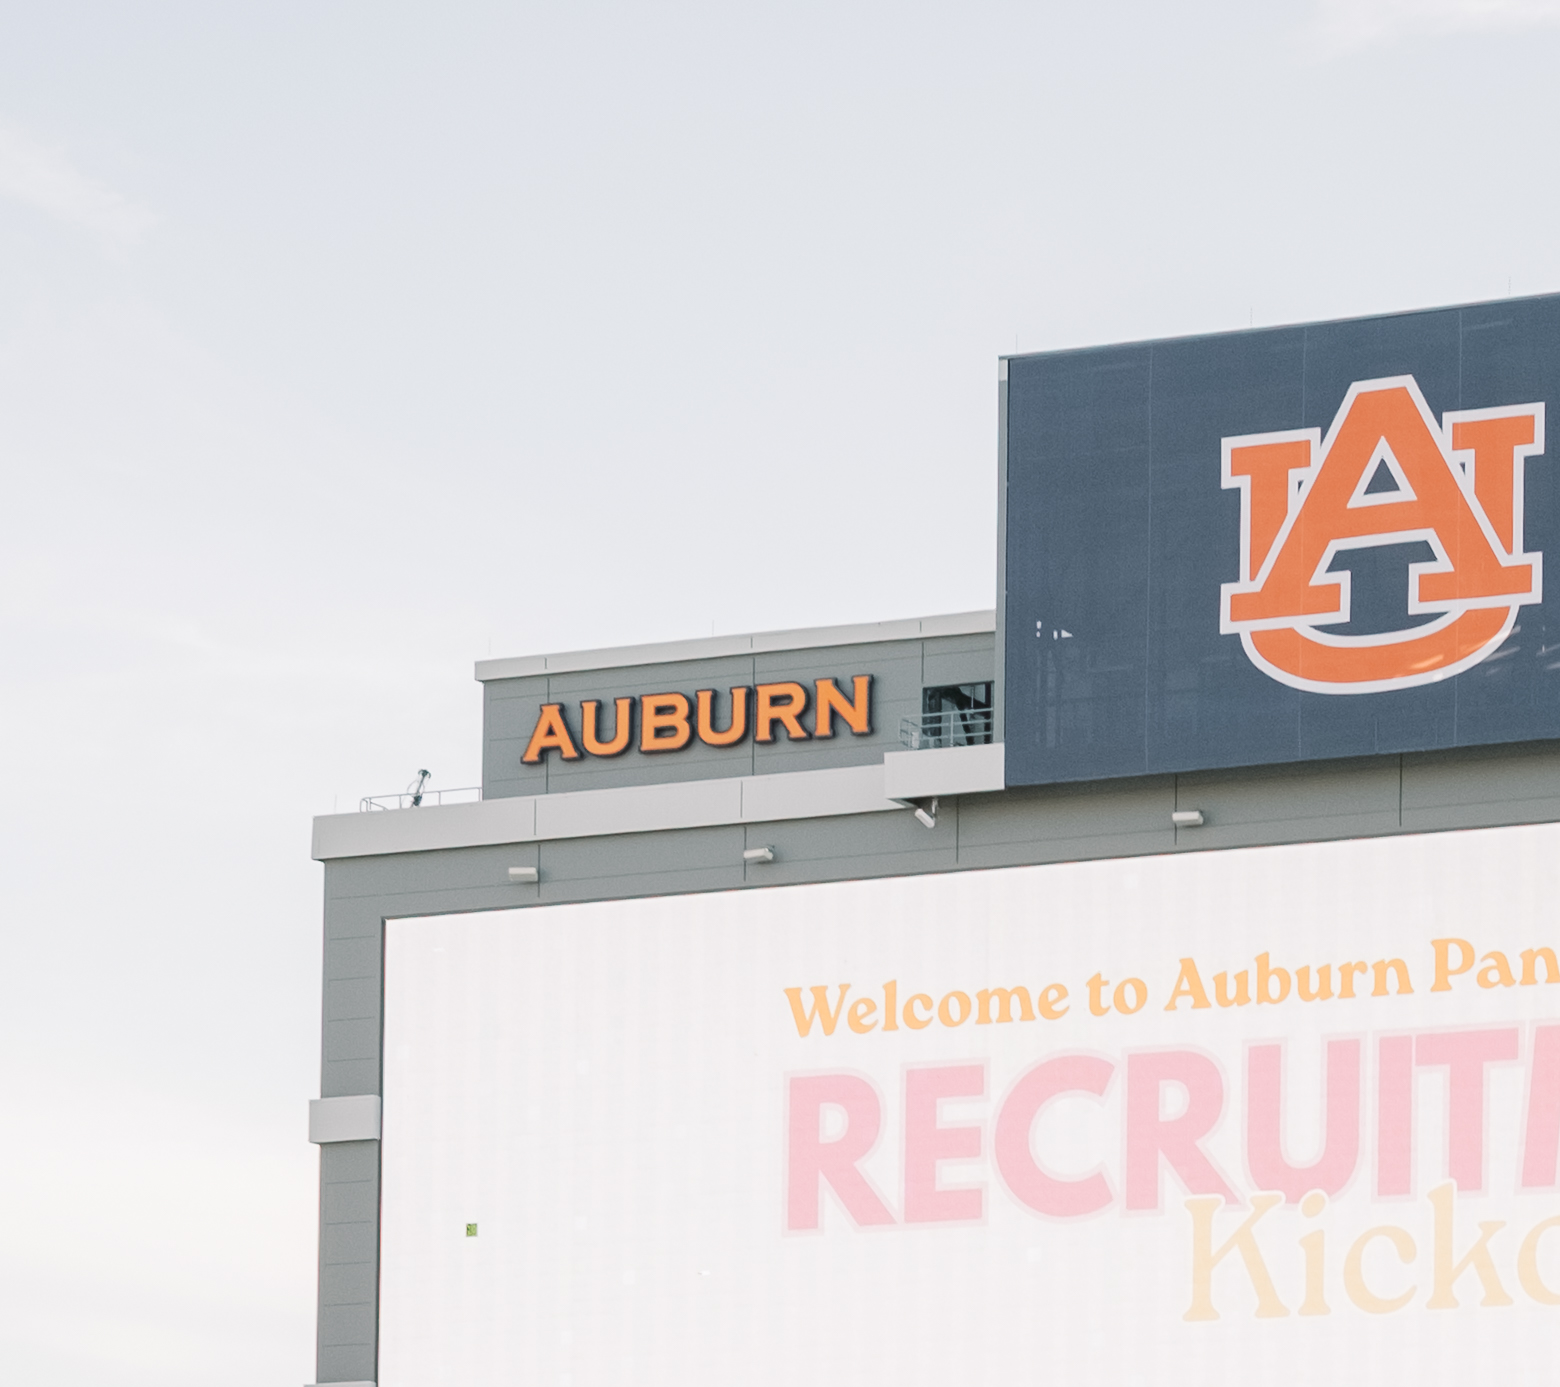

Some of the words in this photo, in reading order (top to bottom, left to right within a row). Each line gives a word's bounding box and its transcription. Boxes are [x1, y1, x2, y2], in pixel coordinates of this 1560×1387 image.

[520, 674, 874, 765] AUBURN
[784, 979, 1070, 1038] Welcome
[1085, 972, 1149, 1018] to
[1164, 951, 1413, 1011] Auburn
